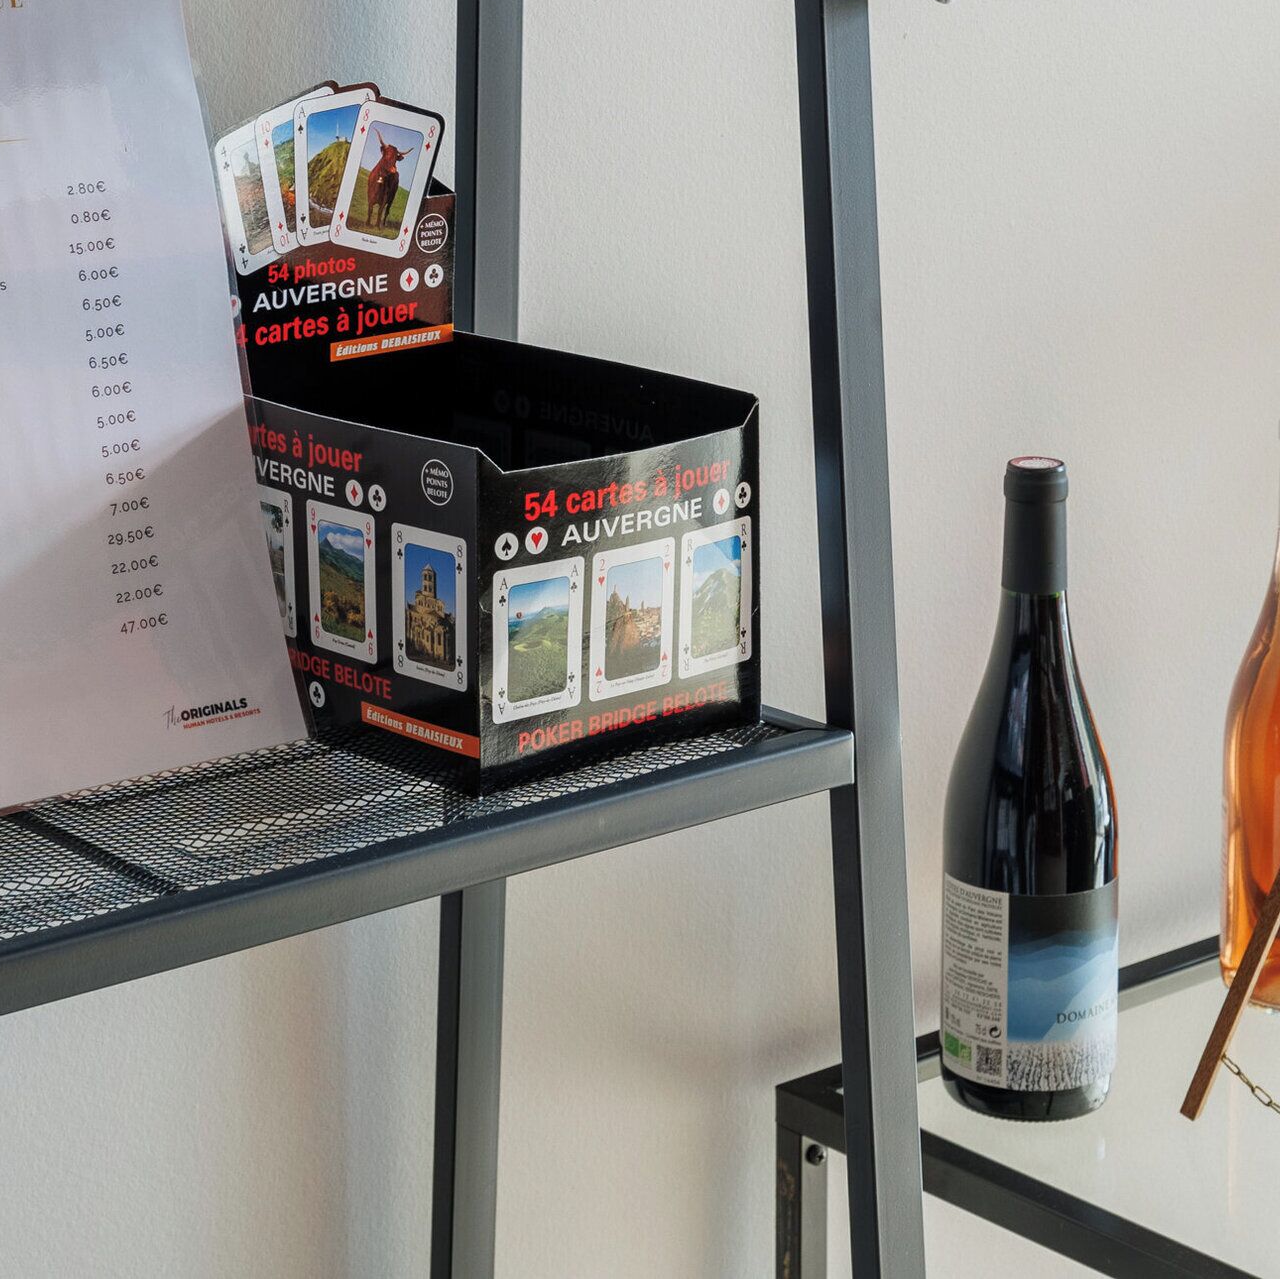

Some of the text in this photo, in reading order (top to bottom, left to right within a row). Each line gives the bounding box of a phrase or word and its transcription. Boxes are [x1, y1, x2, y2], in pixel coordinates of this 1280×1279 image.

[67, 180, 106, 196] 2.80€
[71, 209, 111, 224] 0.80€
[420, 229, 443, 238] POINTS
[421, 237, 442, 247] BELOTE
[69, 237, 116, 255] 15.00€
[78, 266, 119, 282] 6.00€
[268, 257, 356, 284] 54 photos
[82, 294, 122, 311] 6.50€
[253, 273, 388, 313] AUVERGNE
[85, 323, 125, 342] 5.00€
[255, 314, 329, 346] cartes
[337, 307, 350, 332] à
[356, 301, 418, 336] jouer
[335, 330, 441, 357] Éditions DEBAISIEUX
[88, 352, 129, 370] 6.50€
[91, 381, 132, 398] 6.00€
[96, 410, 136, 429] 5.00€
[101, 438, 141, 458] 5.00€
[249, 423, 363, 473] rtes à jouer
[105, 468, 146, 485] 6.50€
[256, 456, 336, 498] VERGNE
[426, 477, 448, 488] POINTS
[427, 487, 448, 499] BELOTE
[524, 460, 731, 521] 54 cartes à jouer
[110, 496, 150, 516] 7.00€
[561, 497, 703, 547] AUVERGNE
[108, 525, 154, 545] 29.50€
[116, 583, 164, 604] 22.00€
[120, 613, 169, 635] 47.00€
[288, 647, 392, 700] RIDGE BELOTE
[180, 697, 248, 721] ORIGINALS
[183, 720, 205, 729] HUMAN
[207, 716, 229, 725] HOTELS
[234, 708, 261, 719] RESORTS
[518, 681, 728, 754] POKER BRIDGE BELOTE
[367, 707, 463, 750] Éditions DEBAISIEUX
